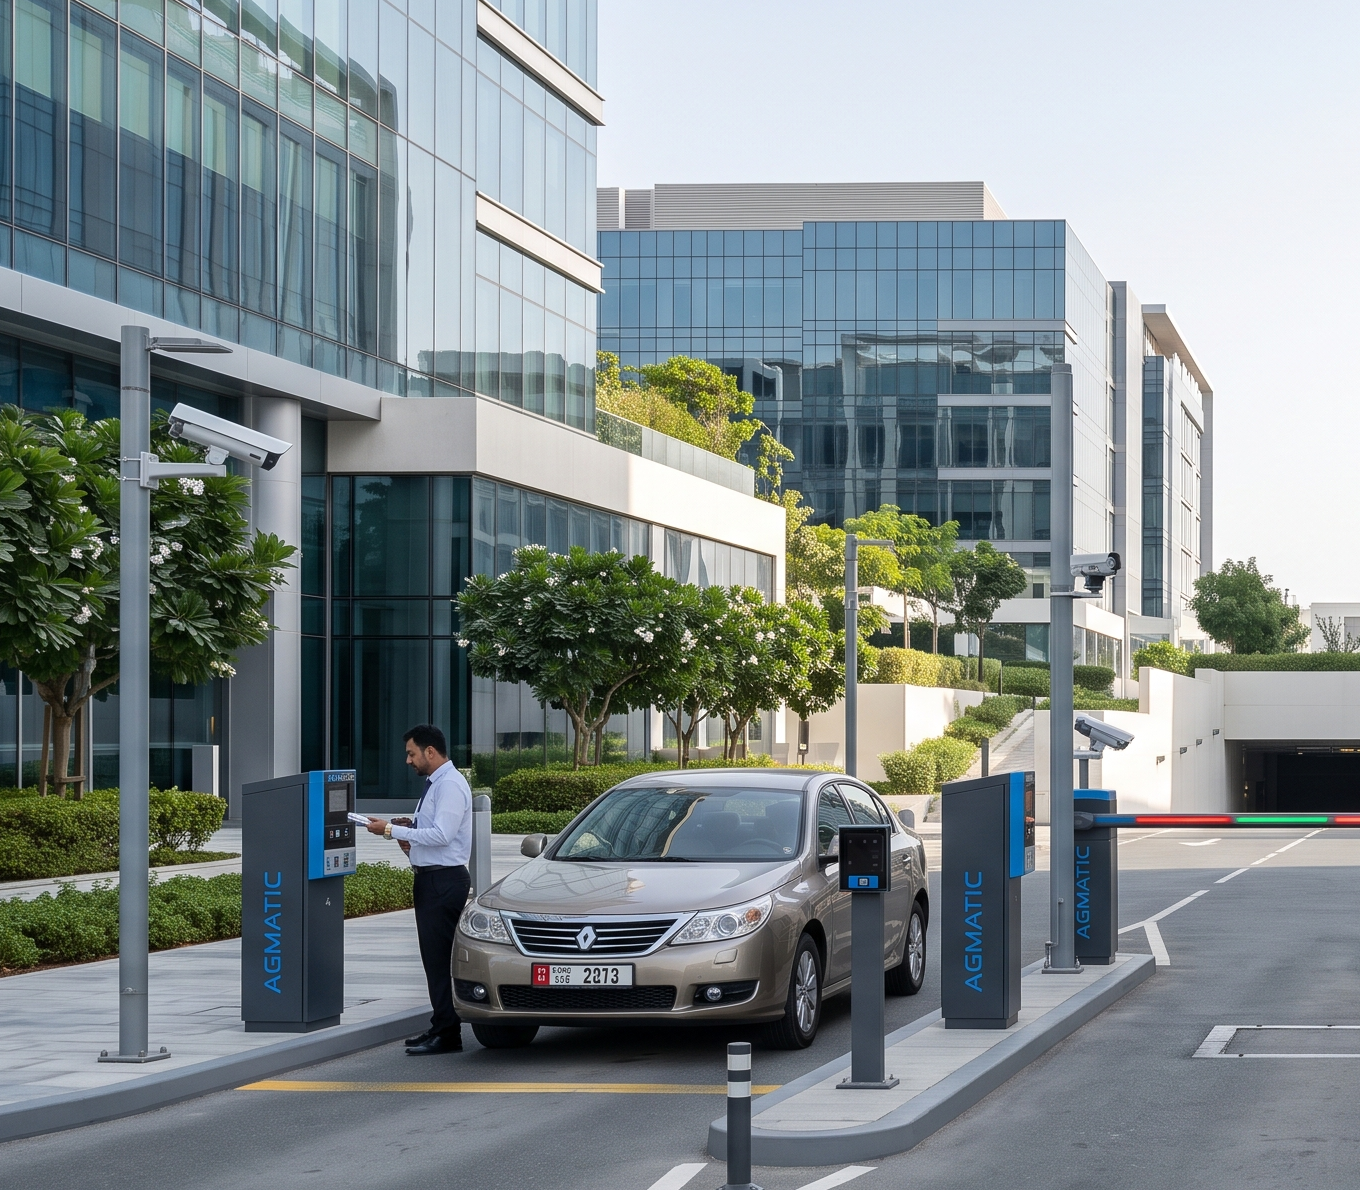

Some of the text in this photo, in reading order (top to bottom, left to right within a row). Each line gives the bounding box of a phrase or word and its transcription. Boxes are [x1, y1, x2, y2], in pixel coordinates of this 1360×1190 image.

[264, 871, 281, 994] AGMATIC
[965, 871, 983, 992] AGMATIC
[1076, 846, 1090, 939] AGMATIC
